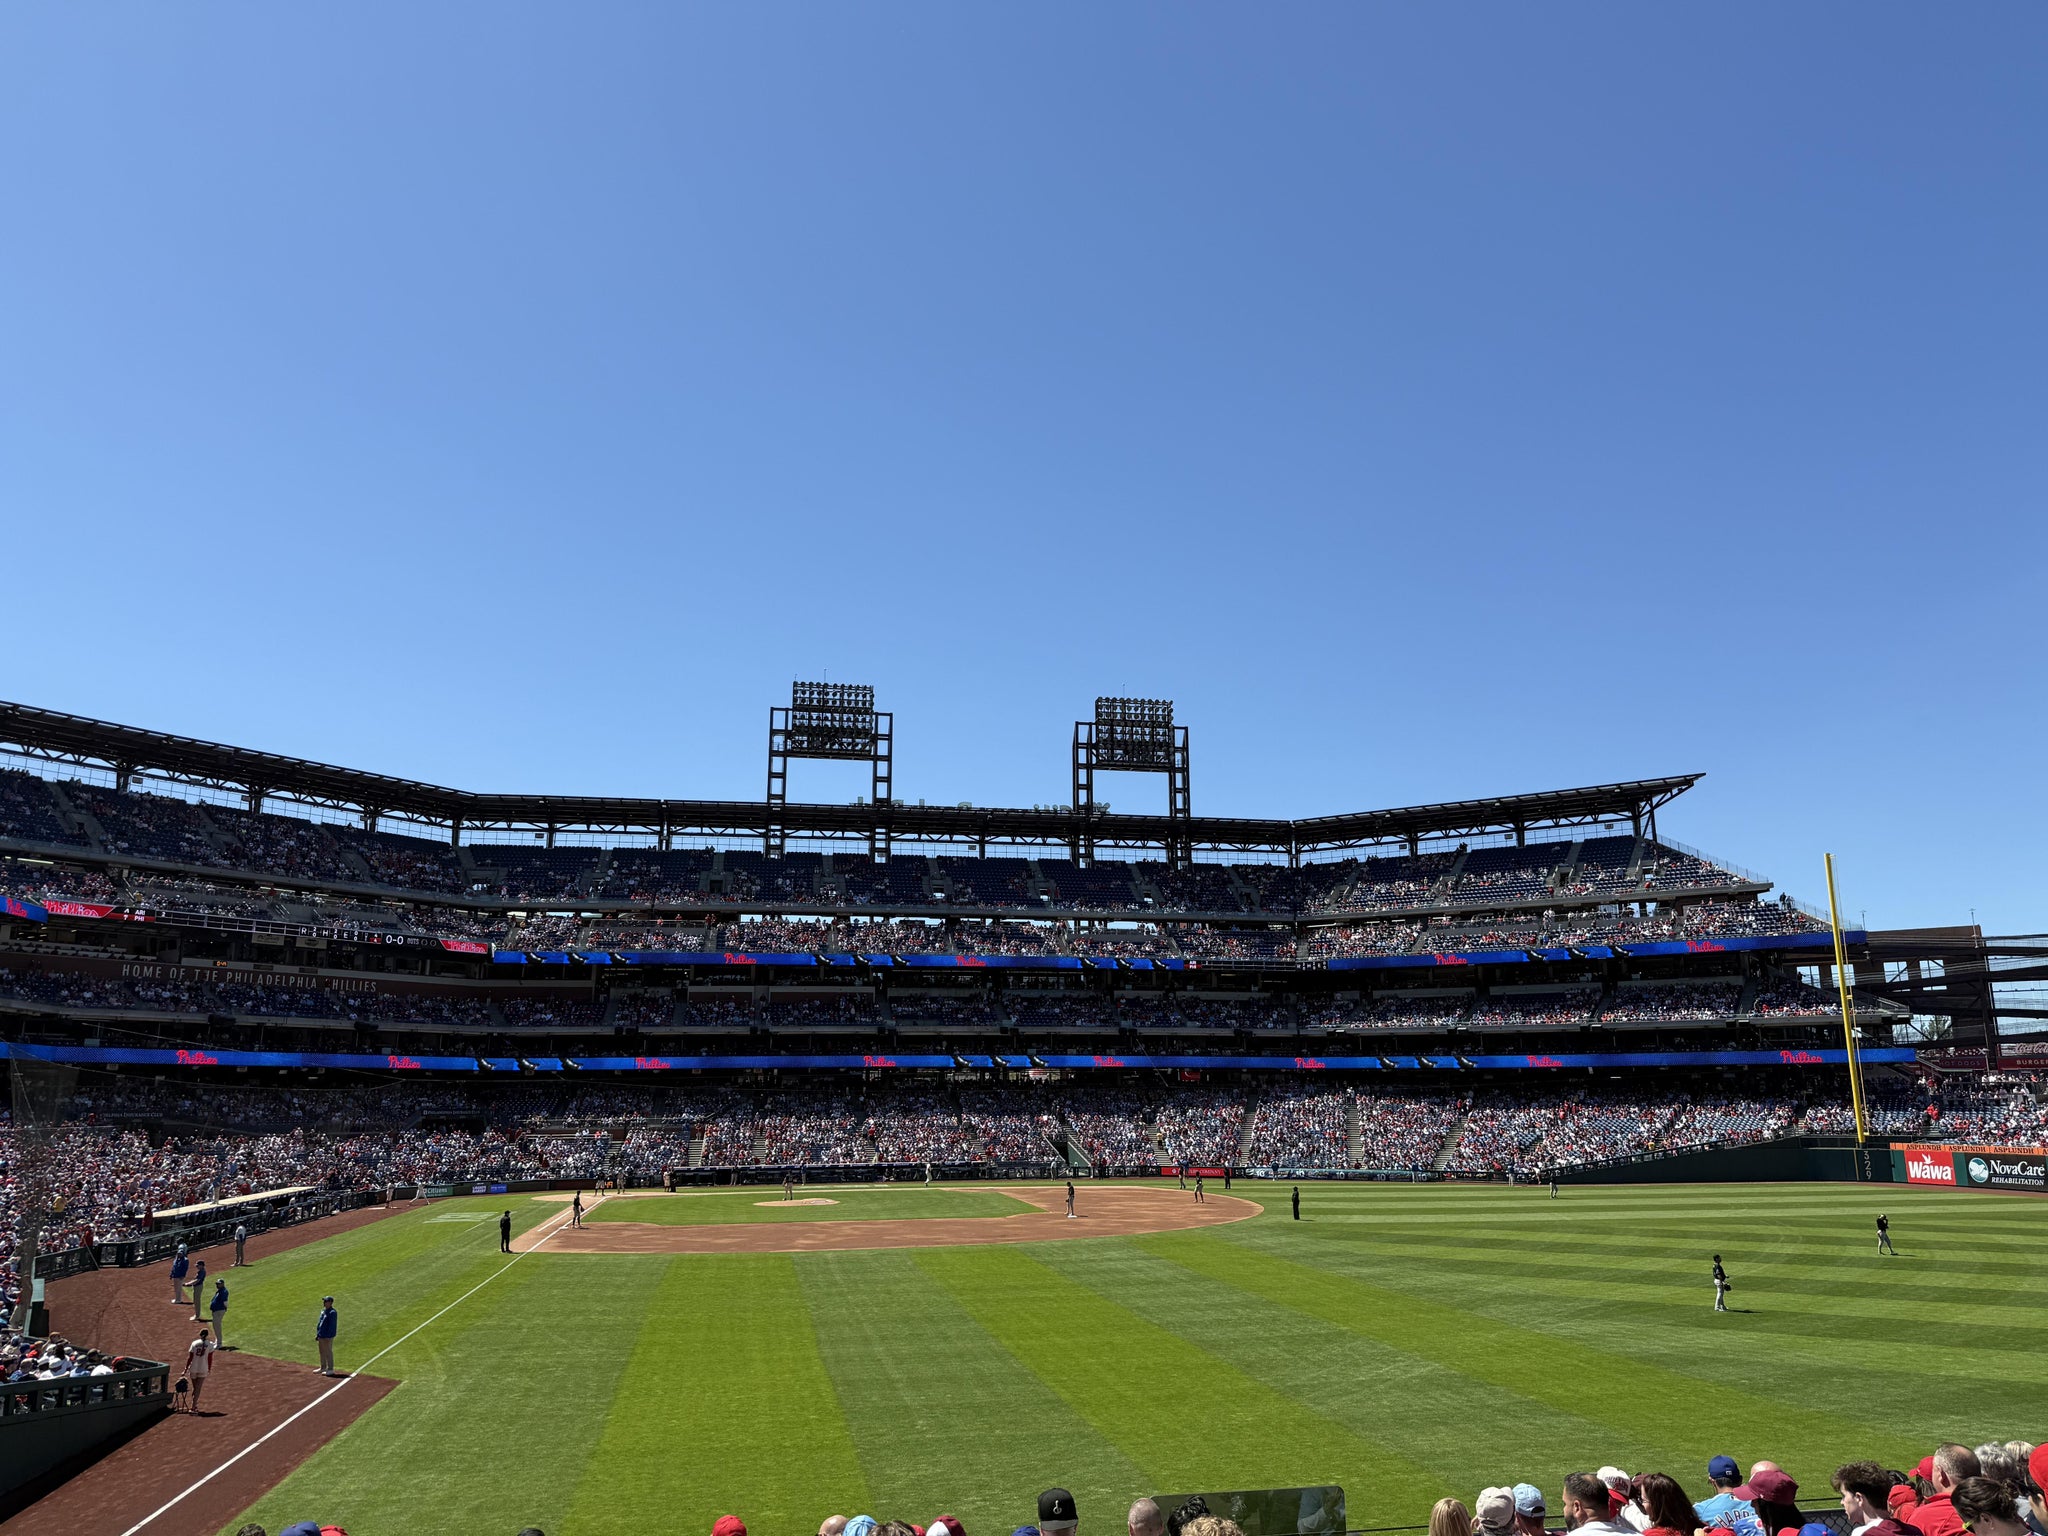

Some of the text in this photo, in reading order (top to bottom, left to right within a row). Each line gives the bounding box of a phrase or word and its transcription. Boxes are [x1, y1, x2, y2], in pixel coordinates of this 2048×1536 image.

[301, 927, 307, 935] R
[322, 929, 329, 937] H
[343, 931, 349, 939] E
[385, 934, 404, 945] 0-0
[1686, 940, 1726, 953] Phillies
[723, 952, 757, 965] Phillies
[955, 955, 986, 967] Phillies
[1434, 953, 1468, 965] Phillies
[122, 964, 162, 979] HOME
[169, 967, 185, 979] OF
[226, 971, 317, 989] PHILADELPHIA
[327, 978, 377, 992] HILLIES
[176, 1049, 218, 1065] Phillies
[387, 1055, 421, 1069] Phillies
[635, 1056, 671, 1070] Phillies
[863, 1055, 896, 1068] Phillies
[1093, 1055, 1124, 1067] Phillies
[1294, 1057, 1326, 1069] Phillies
[1526, 1055, 1563, 1068] Phillies
[1779, 1050, 1824, 1064] Phillies
[1906, 1143, 1942, 1151] ASPLUNDH
[1948, 1145, 1986, 1153] ASPLUNDH
[1993, 1147, 2035, 1155] ASPLUNDH
[1863, 1150, 1872, 1180] 329
[1908, 1160, 1953, 1181] Wawa
[1989, 1159, 2045, 1177] NovaCare
[1991, 1176, 2045, 1186] REHABILITATION
